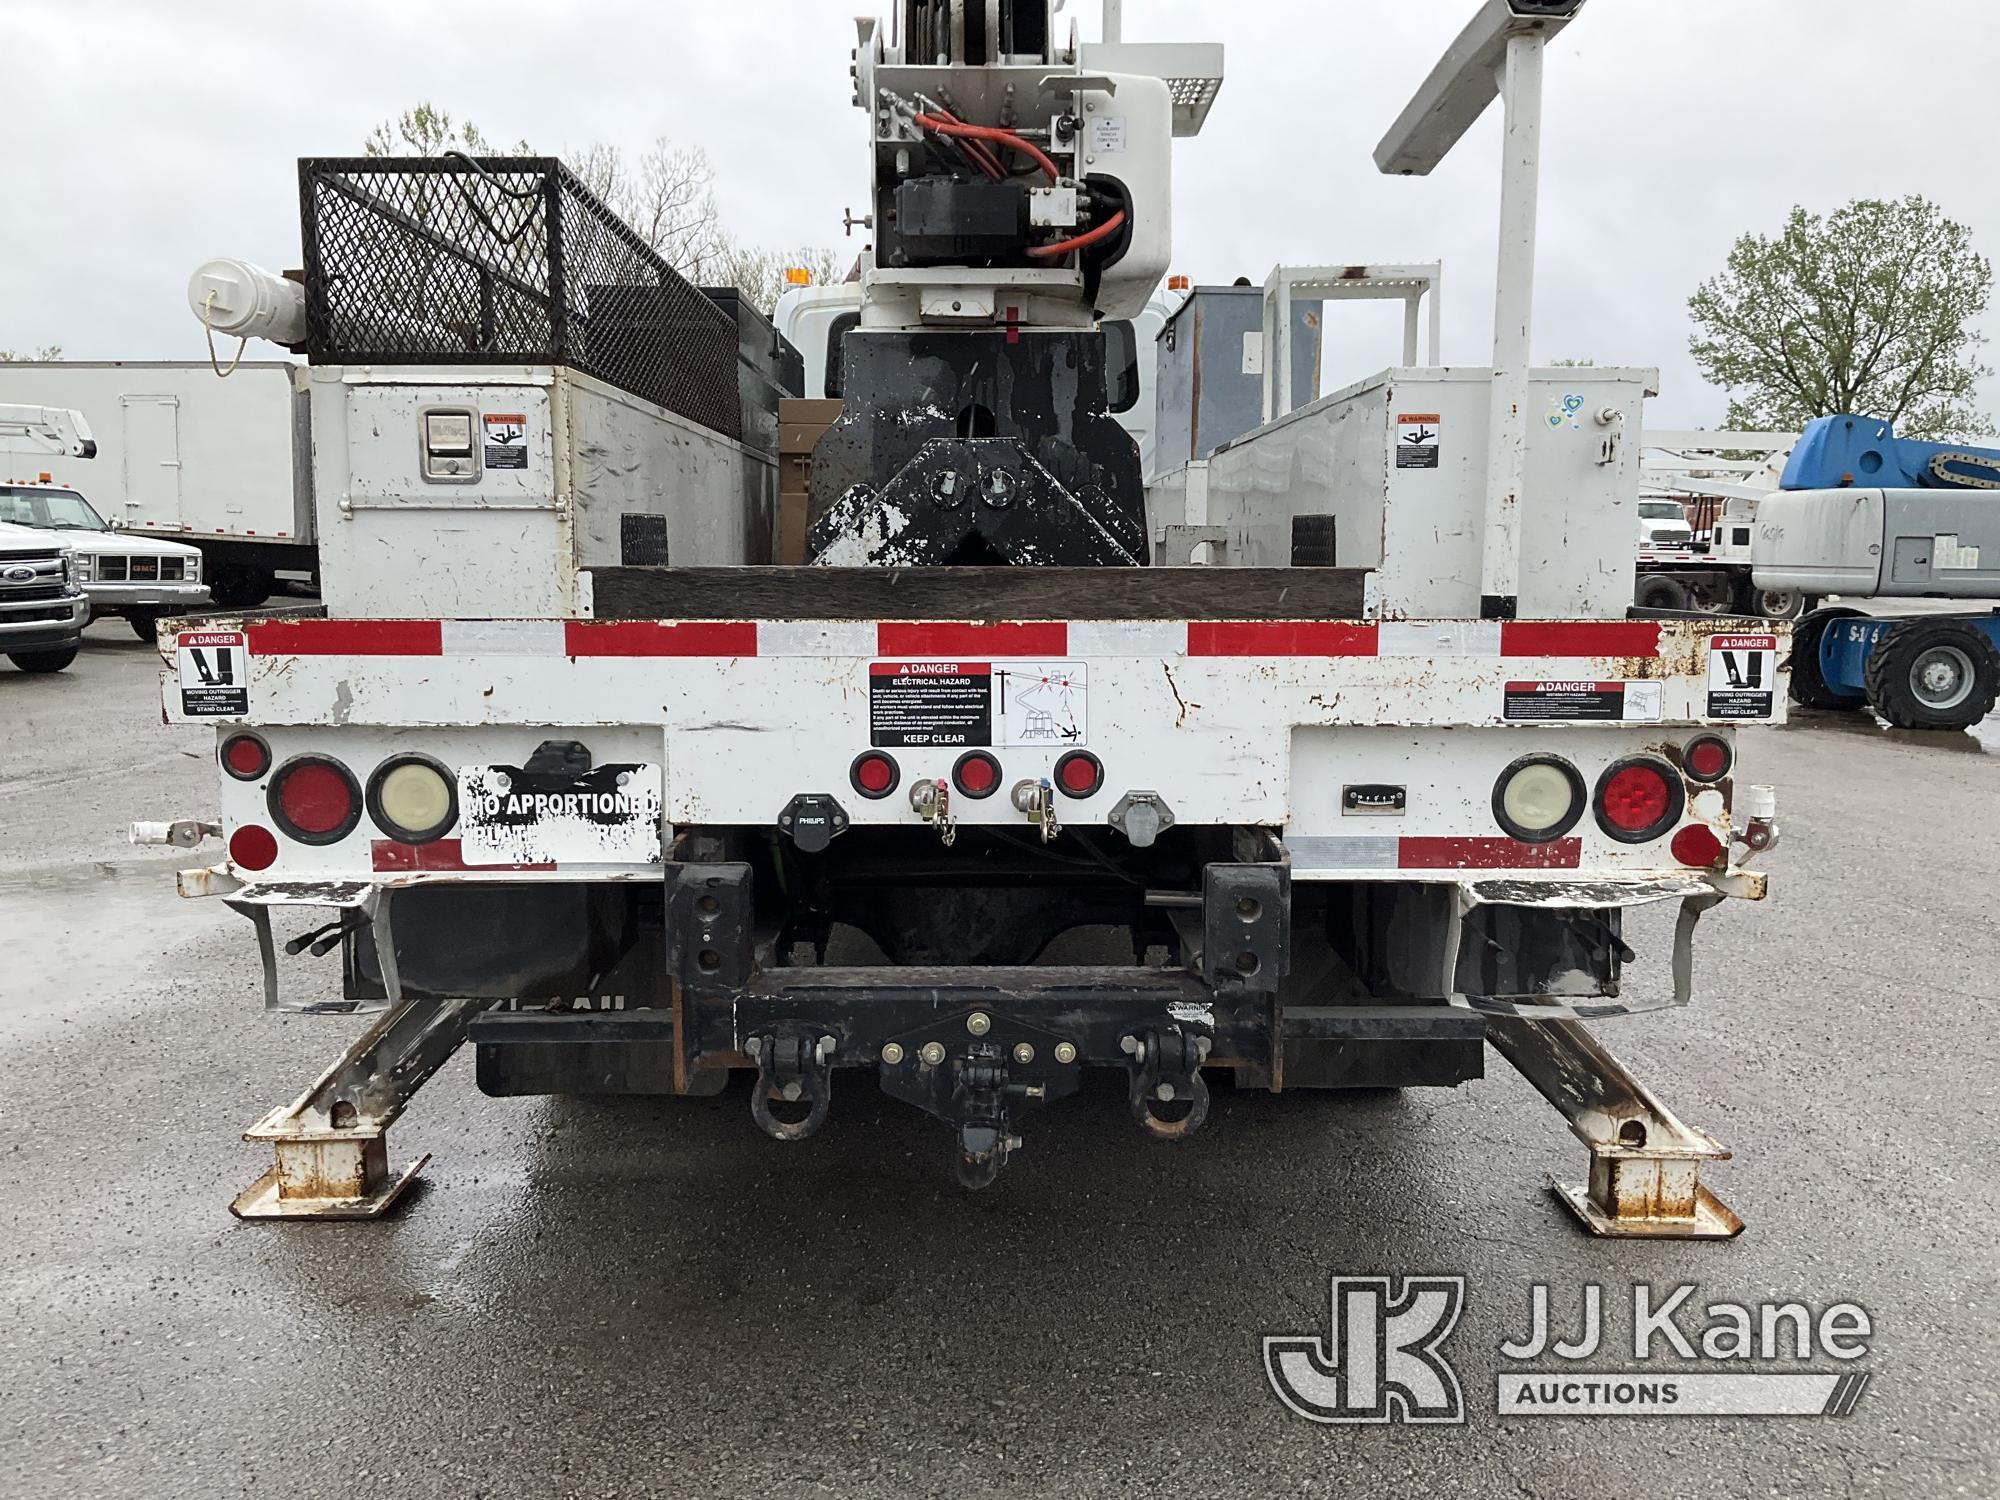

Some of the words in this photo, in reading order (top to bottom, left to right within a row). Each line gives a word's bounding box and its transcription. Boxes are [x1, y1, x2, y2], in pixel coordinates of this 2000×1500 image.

[132, 564, 157, 573] GMC
[197, 635, 236, 644] DANGER
[1730, 638, 1769, 647] DANGER
[911, 664, 959, 674] DANGER
[892, 678, 939, 686] ELECTRICAL
[939, 678, 971, 686] HAZARD
[1545, 682, 1596, 692] DANGER
[903, 734, 930, 744] KEEP
[931, 734, 965, 744] CLEAR
[469, 795, 500, 815] MO
[506, 793, 656, 815] APPORTIONED
